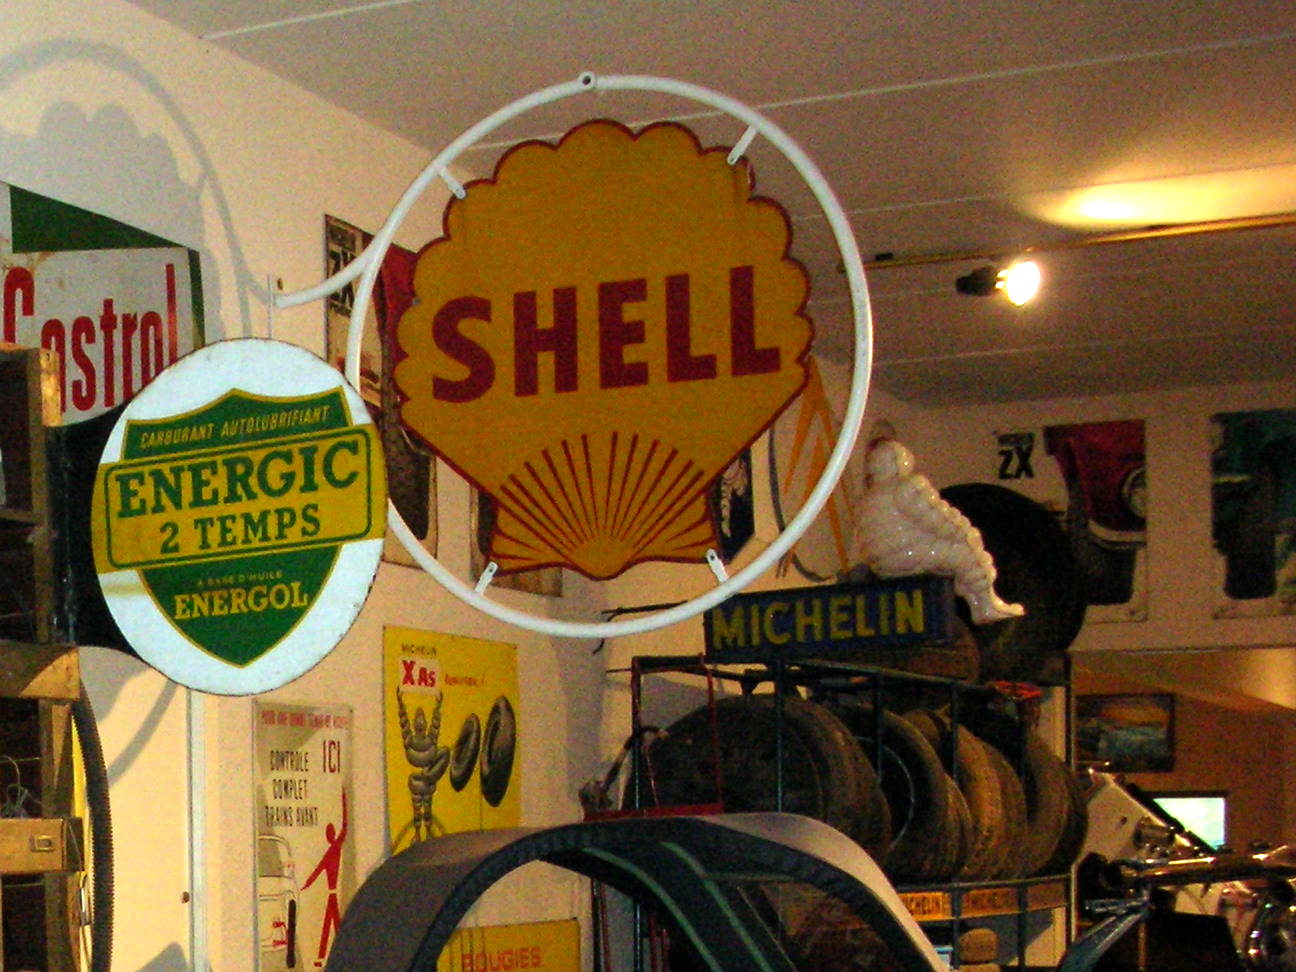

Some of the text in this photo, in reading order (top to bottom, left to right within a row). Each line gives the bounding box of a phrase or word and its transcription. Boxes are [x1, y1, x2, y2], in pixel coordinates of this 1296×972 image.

[2, 263, 179, 413] Castrol
[432, 265, 782, 403] SHELL
[141, 405, 330, 450] CARBURANT AUTOLUBRIFIANT
[115, 439, 360, 518] ENERGIC
[159, 503, 321, 554] 2 TEMPS
[174, 580, 309, 620] ENERGOL
[712, 588, 925, 650] MICHELIN
[322, 740, 341, 773] ICI
[272, 778, 308, 800] COMPLET
